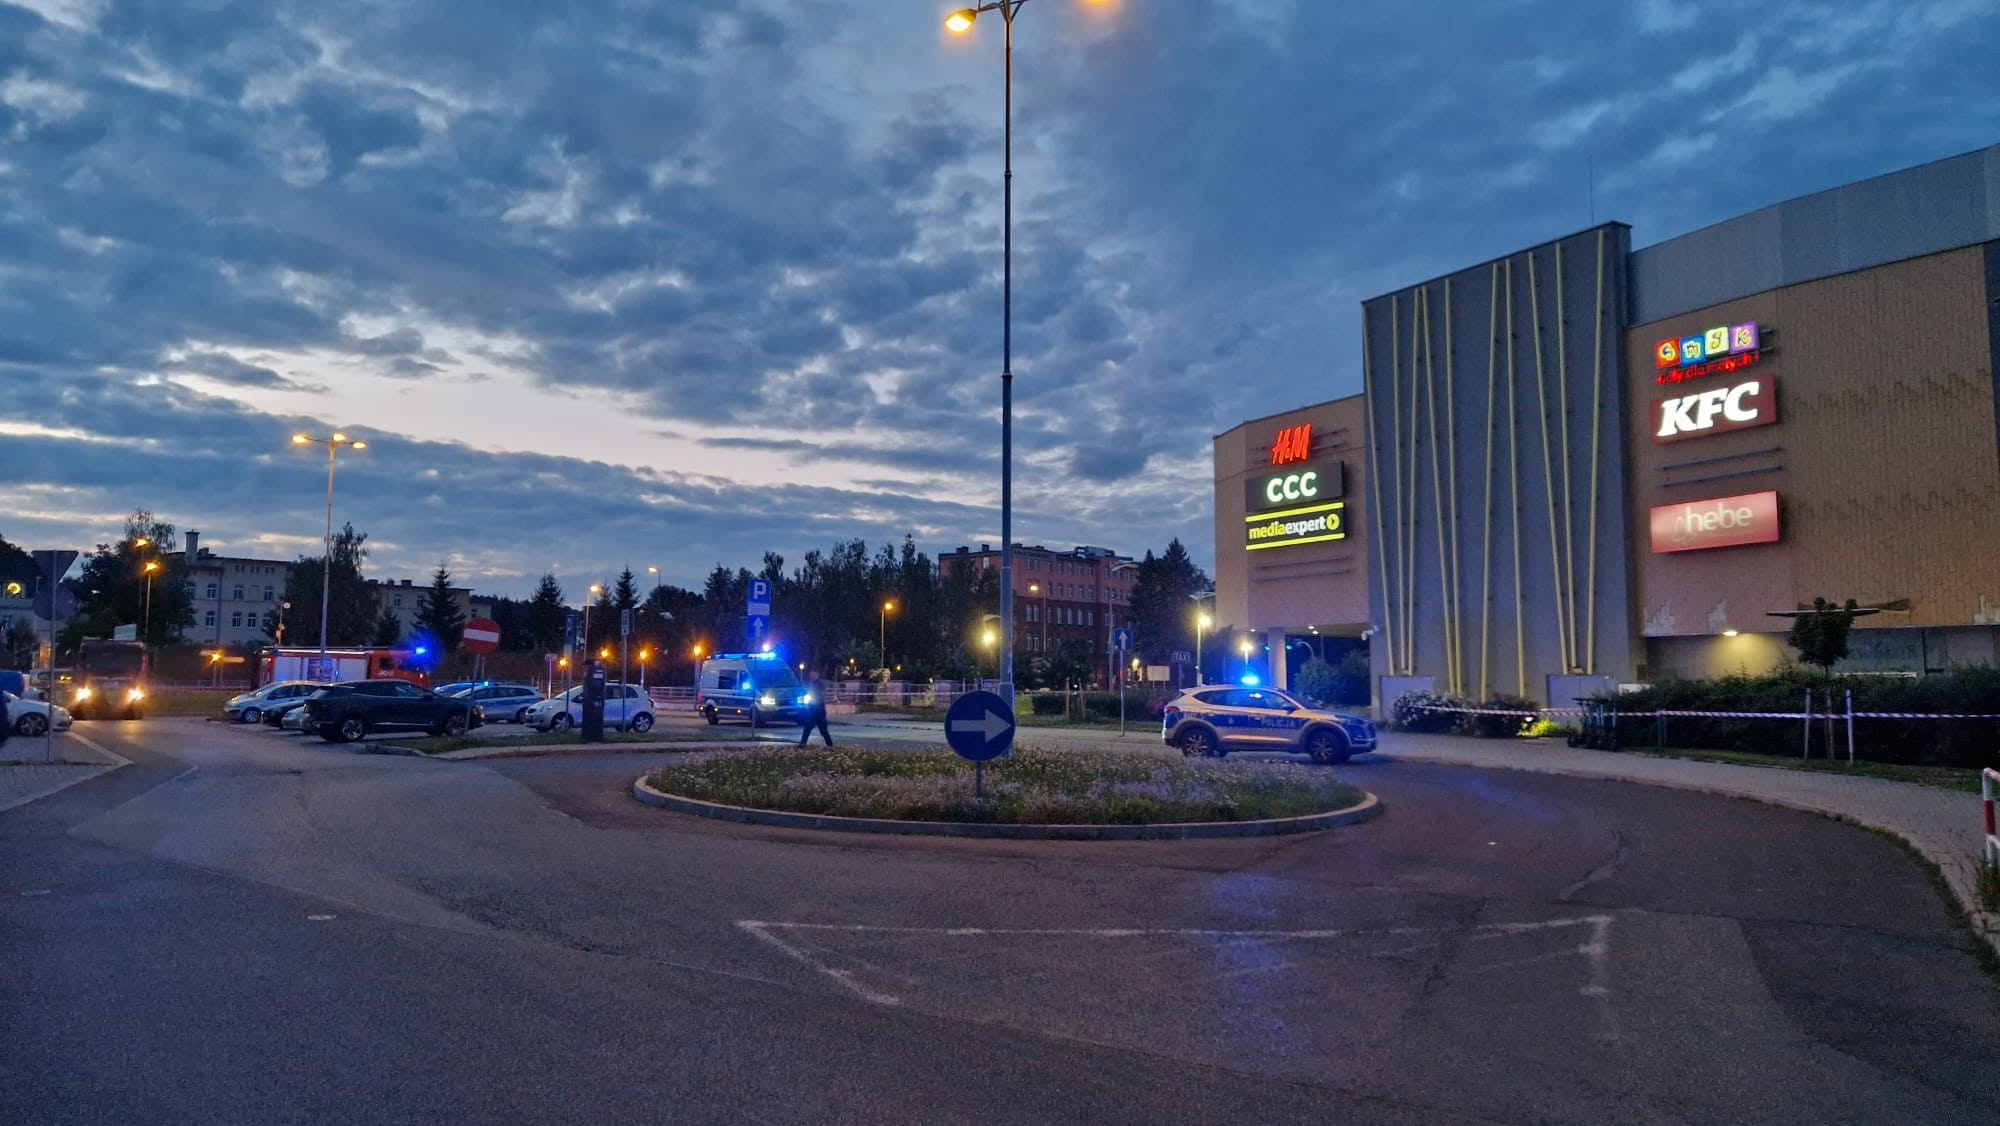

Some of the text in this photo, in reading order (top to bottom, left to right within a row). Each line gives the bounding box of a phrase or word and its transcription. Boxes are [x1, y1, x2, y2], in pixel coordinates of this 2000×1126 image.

[1656, 381, 1760, 436] KFC
[1272, 423, 1312, 465] H&M
[1266, 471, 1317, 502] CCC
[1249, 515, 1326, 540] mediaexpert
[1686, 502, 1753, 533] hebe
[754, 581, 767, 600] P
[1261, 717, 1297, 729] POLICJA
